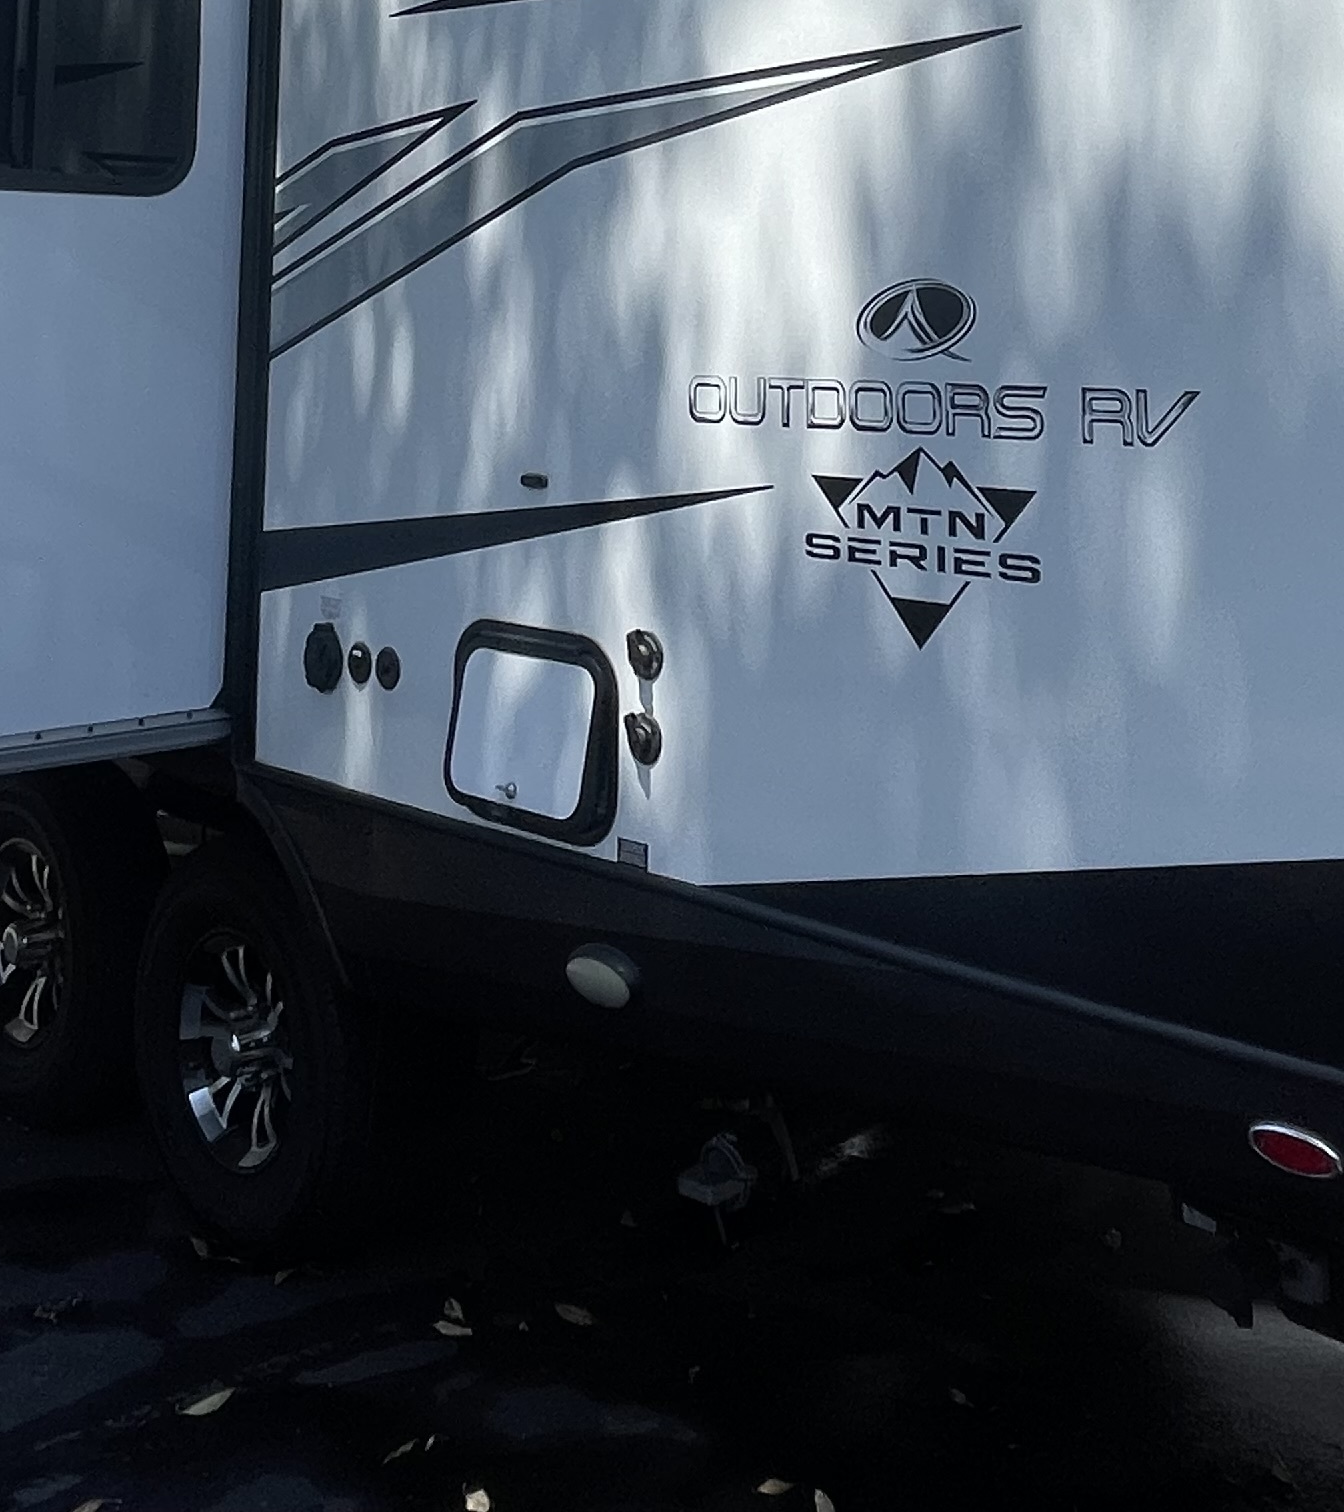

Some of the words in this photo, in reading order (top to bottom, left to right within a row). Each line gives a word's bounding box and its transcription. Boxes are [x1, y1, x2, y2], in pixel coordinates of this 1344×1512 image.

[688, 374, 1048, 440] OUTDOORS
[1081, 386, 1201, 447] RV
[856, 502, 986, 541] MTN
[804, 531, 1042, 584] SERIES
